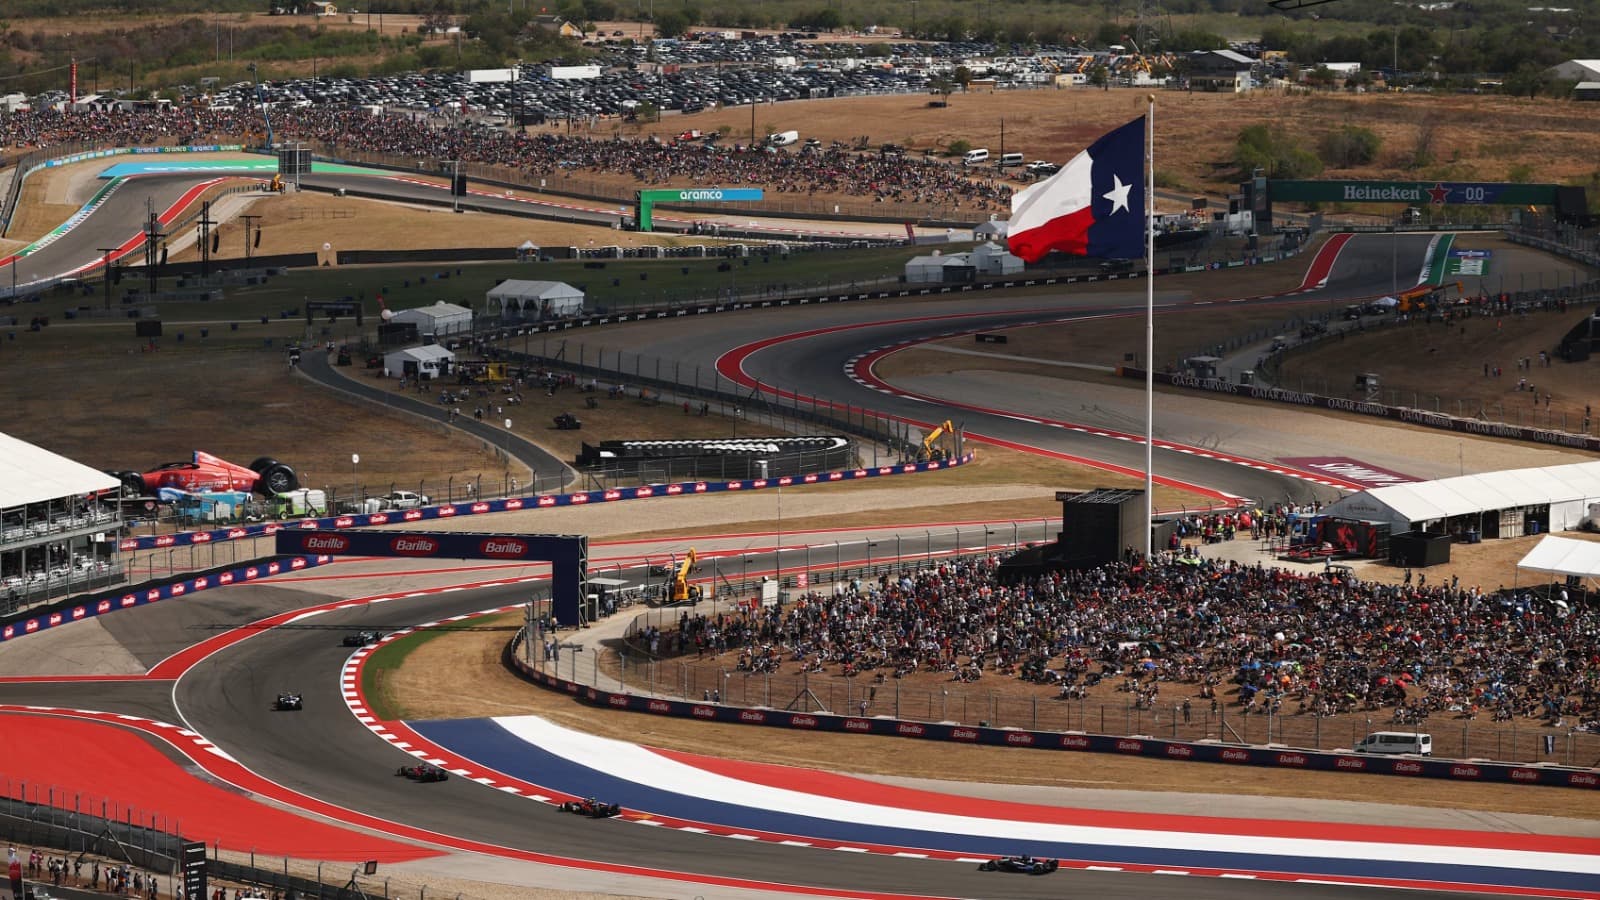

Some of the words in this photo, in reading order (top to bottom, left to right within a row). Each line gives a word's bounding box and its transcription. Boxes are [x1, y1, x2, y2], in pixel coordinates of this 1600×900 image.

[680, 190, 722, 200] aramco
[1344, 186, 1420, 200] Heineken
[1171, 376, 1199, 387] QATAR
[1201, 380, 1237, 393] AIRWAYS
[1251, 388, 1280, 400] QATAR
[1281, 391, 1314, 404] AIRWAYS
[1328, 398, 1354, 410] QATAR
[1356, 402, 1388, 416] AIRWAYS
[1400, 410, 1422, 423] QATAR
[1465, 422, 1489, 435] QATAR
[1491, 424, 1522, 437] AIRWAYS
[308, 538, 344, 549] Barilla
[396, 540, 433, 551] Barilla
[485, 542, 522, 553] Barilla
[693, 707, 713, 716] Barilla
[742, 712, 763, 721] Barilla
[792, 717, 815, 726] Barilla
[846, 721, 869, 729] Barilla
[899, 724, 922, 734] Barilla
[953, 729, 976, 738] Barilla
[1008, 734, 1032, 743] Barilla
[1064, 737, 1087, 746] Barilla
[1119, 741, 1141, 750] Barilla
[1168, 746, 1191, 756] Barilla
[1222, 751, 1248, 760] Barilla
[1280, 755, 1305, 764] Barilla
[1338, 759, 1363, 768] Barilla
[1395, 762, 1421, 772] Barilla
[1453, 767, 1478, 776] Barilla
[1512, 771, 1538, 780] Barilla
[1571, 775, 1597, 784] Barilla
